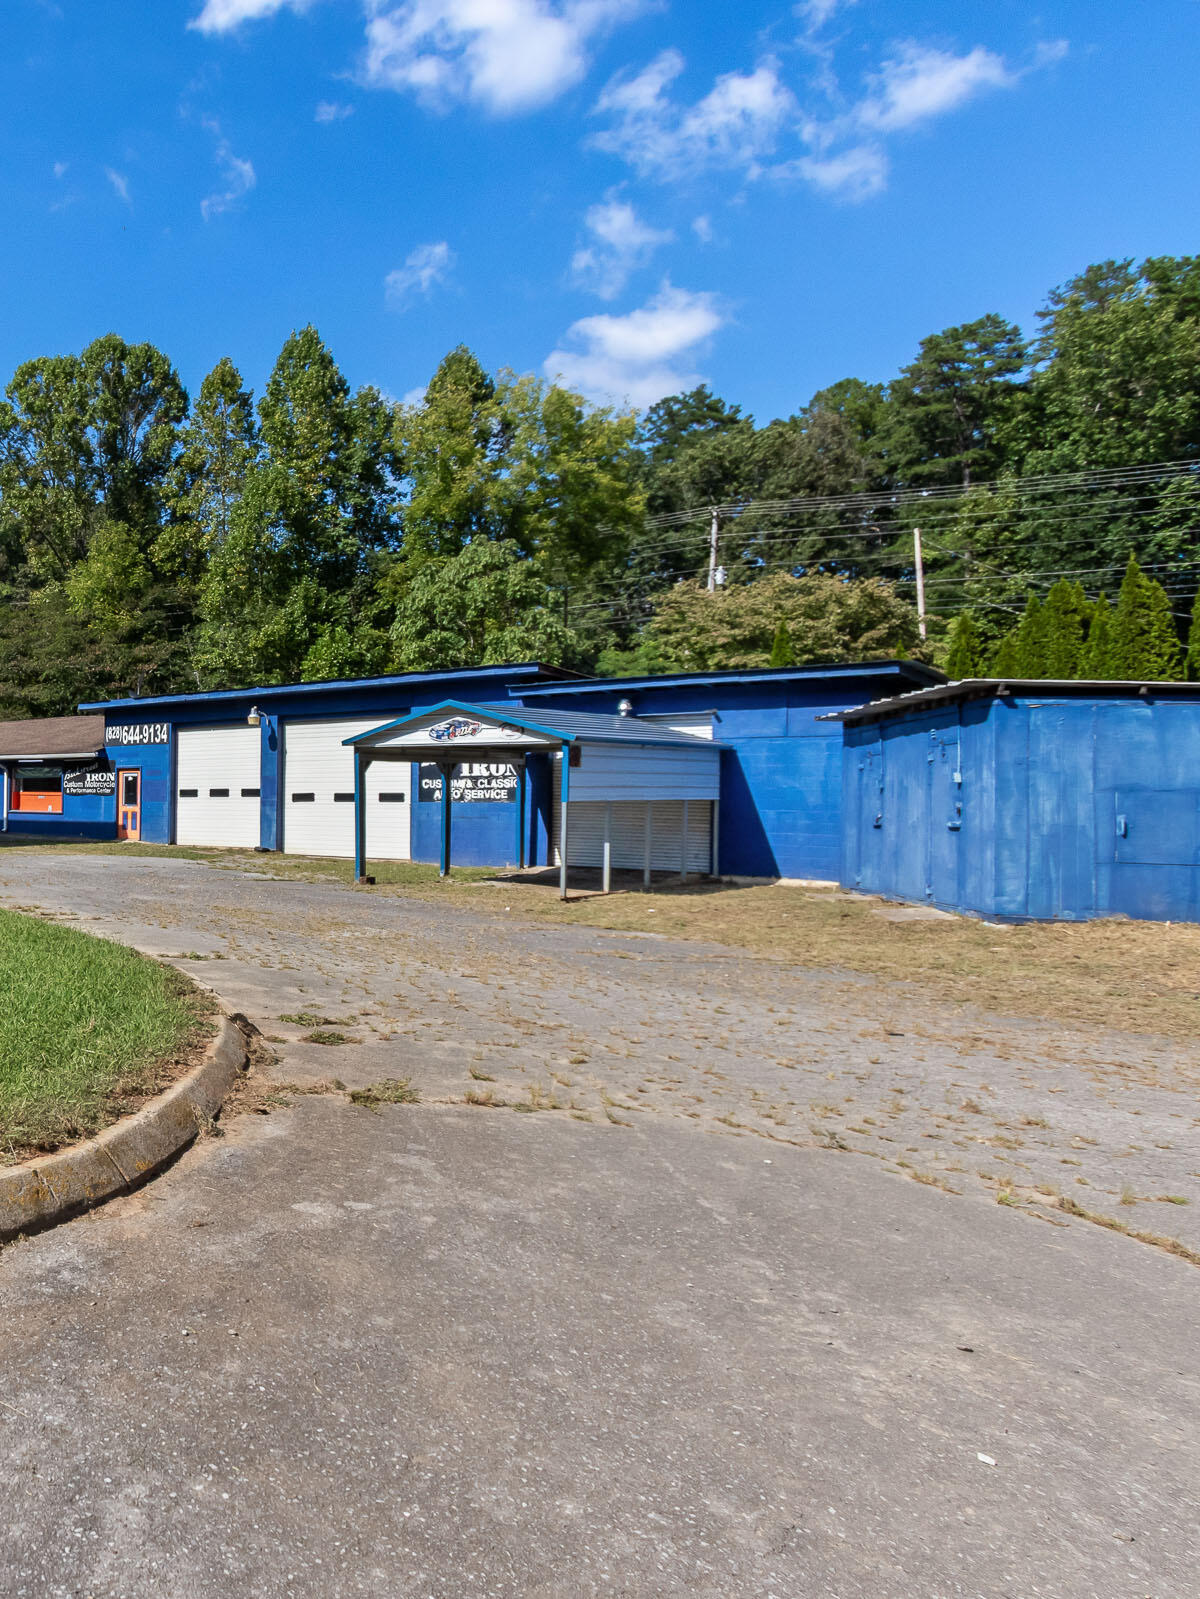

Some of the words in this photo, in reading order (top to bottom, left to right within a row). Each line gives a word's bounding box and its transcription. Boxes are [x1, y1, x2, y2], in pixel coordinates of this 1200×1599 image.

[122, 723, 168, 744] 644-9134
[86, 772, 116, 782] IRON
[64, 780, 84, 788] Custom
[85, 780, 116, 788] Motorcycle
[466, 789, 508, 799] SERVICE
